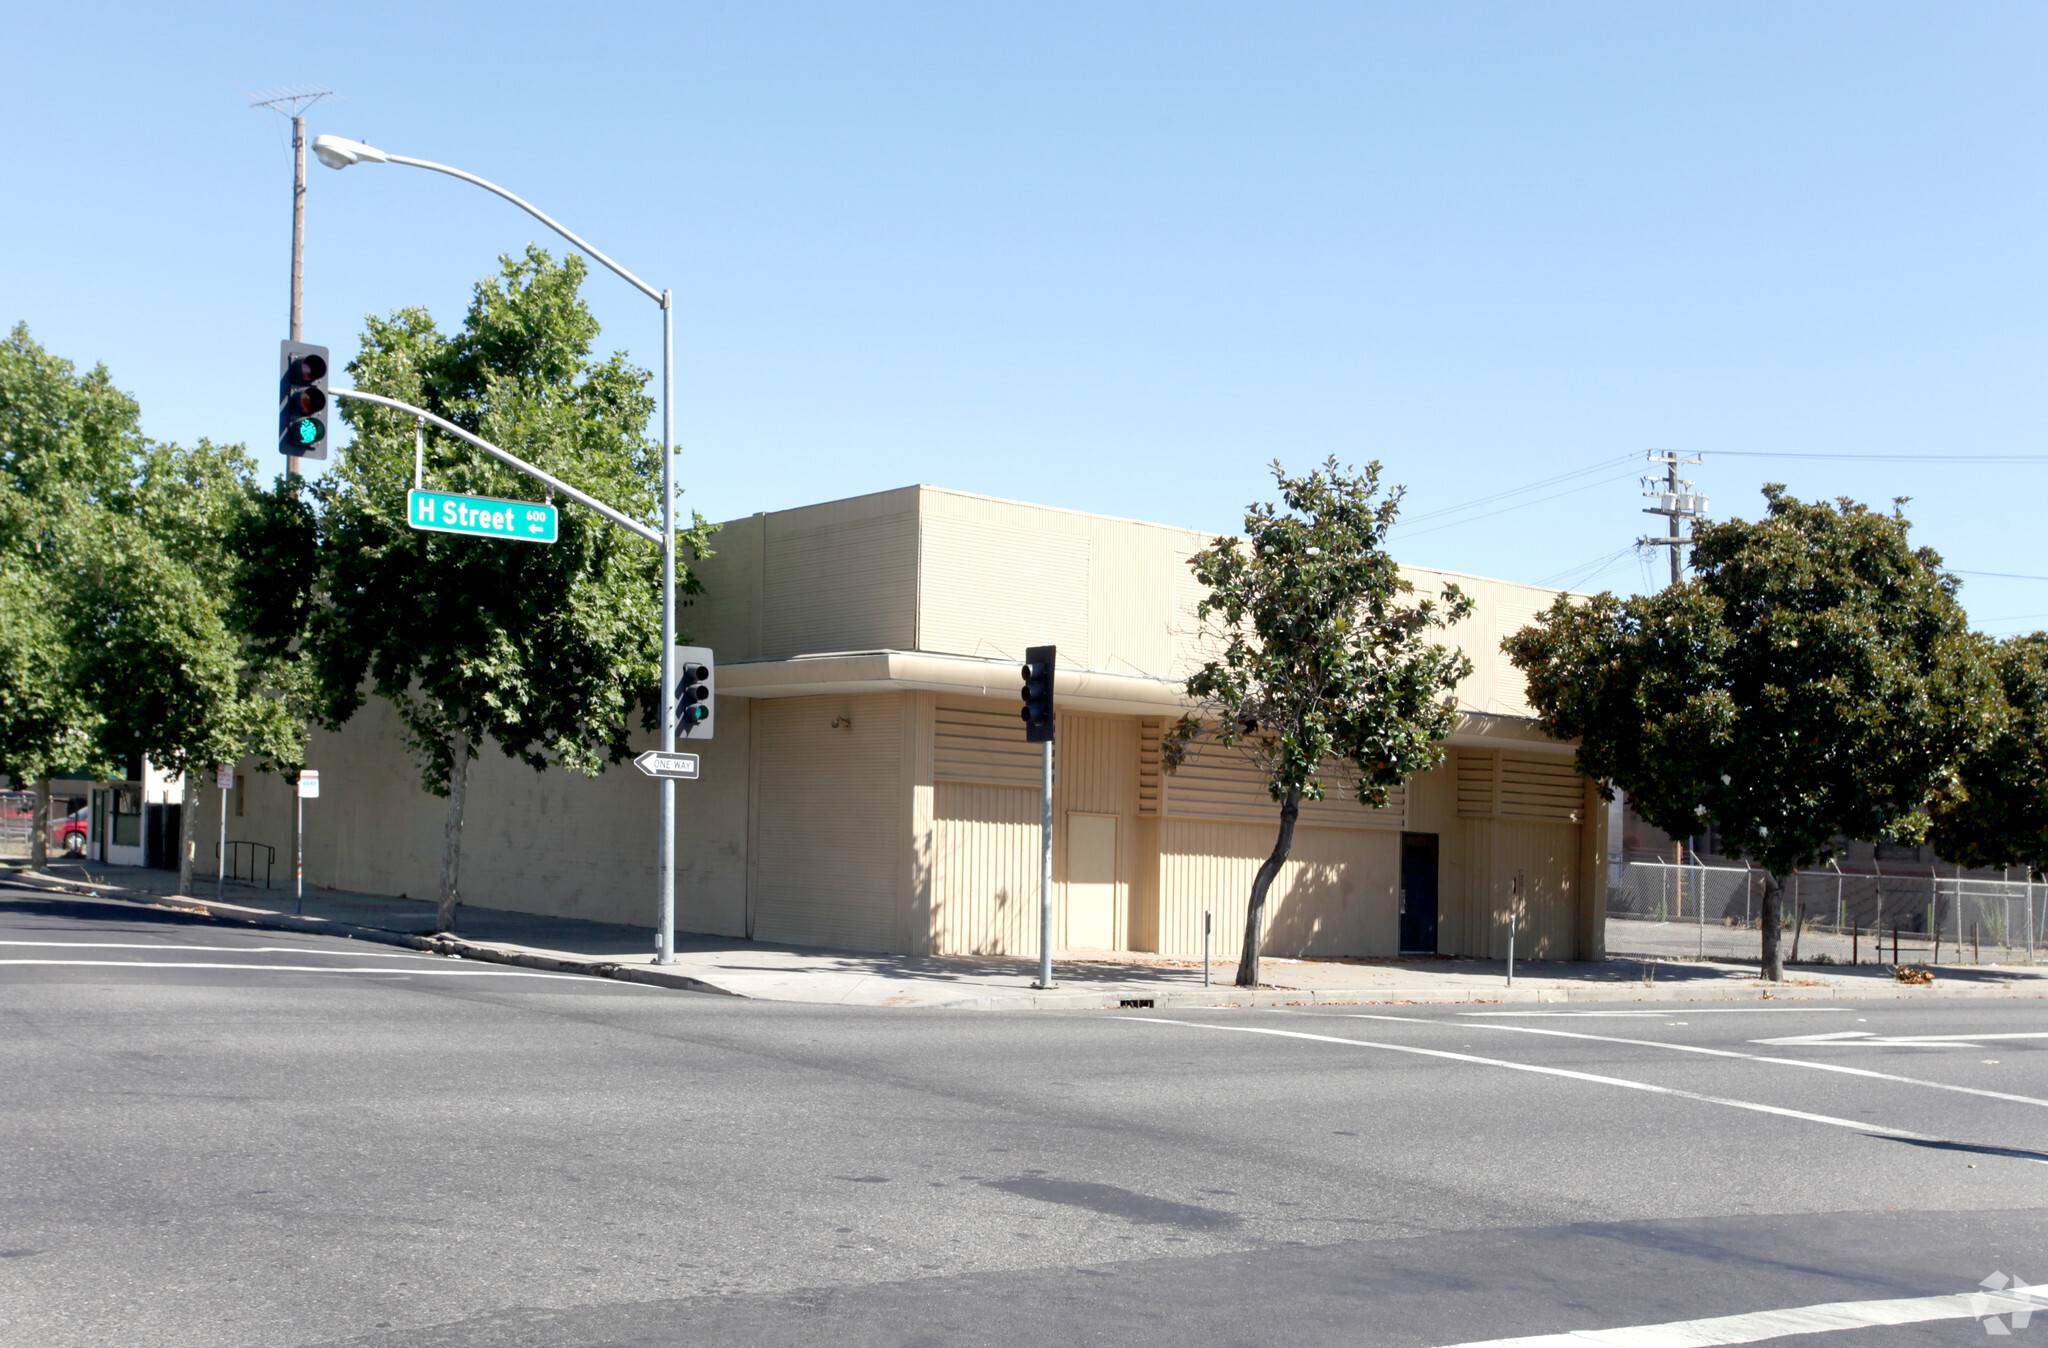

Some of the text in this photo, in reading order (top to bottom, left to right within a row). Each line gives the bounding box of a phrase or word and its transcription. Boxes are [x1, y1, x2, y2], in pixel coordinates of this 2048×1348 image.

[418, 497, 515, 531] H Street
[526, 511, 546, 522] 600
[654, 759, 692, 770] ONE WAY
